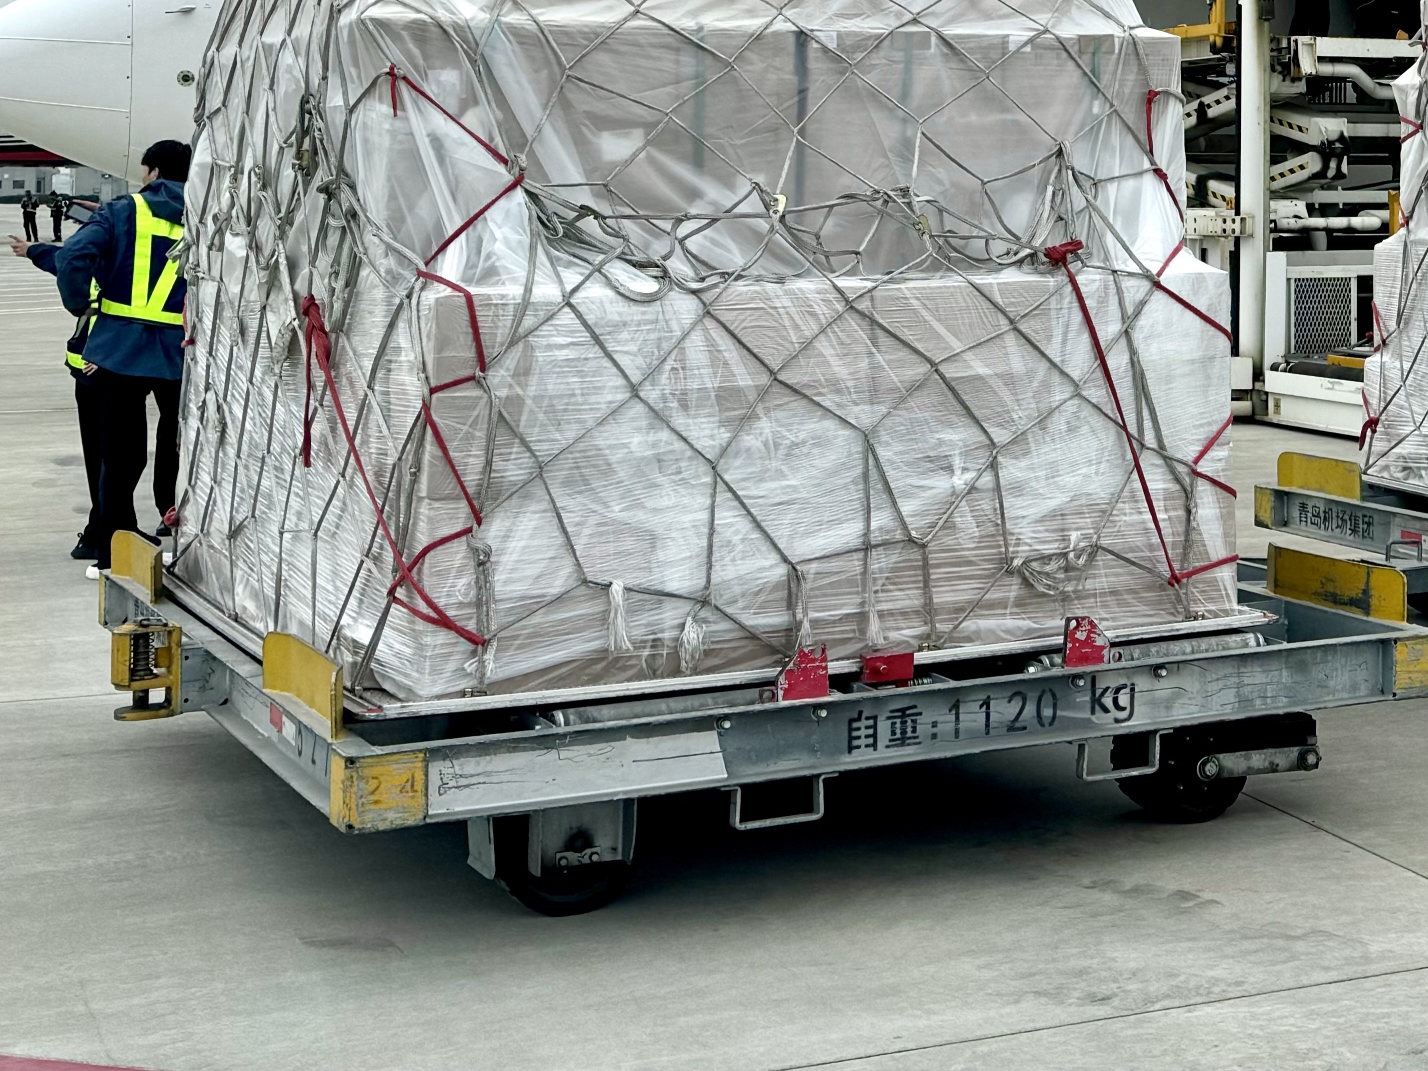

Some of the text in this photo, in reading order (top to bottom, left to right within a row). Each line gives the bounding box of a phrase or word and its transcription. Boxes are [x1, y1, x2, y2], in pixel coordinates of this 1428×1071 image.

[1297, 501, 1375, 541] 青岛机场集团
[1089, 674, 1136, 724] kg
